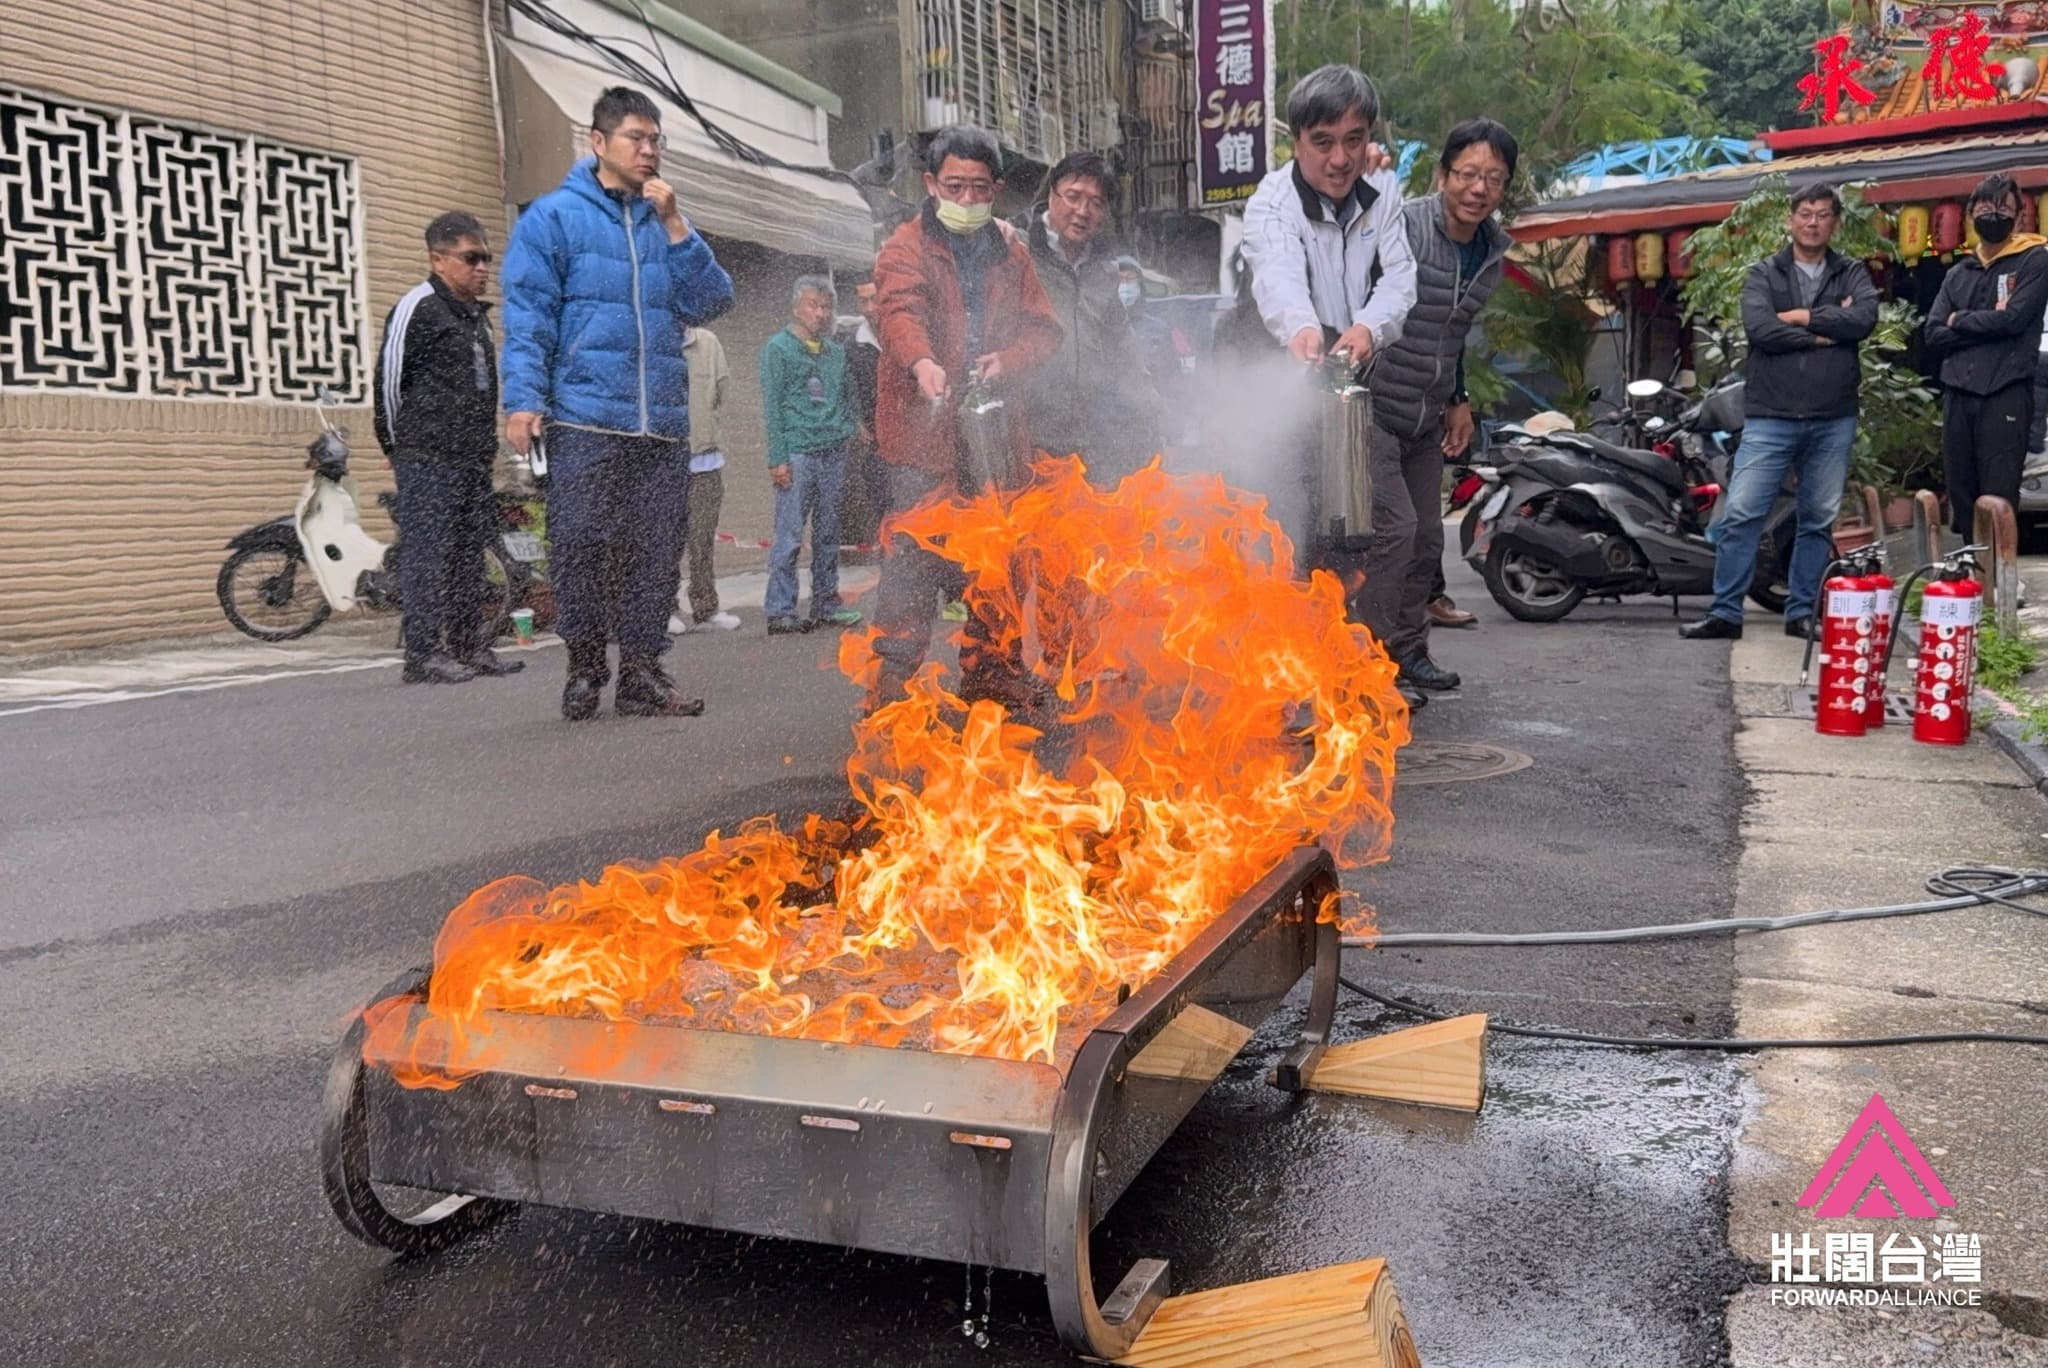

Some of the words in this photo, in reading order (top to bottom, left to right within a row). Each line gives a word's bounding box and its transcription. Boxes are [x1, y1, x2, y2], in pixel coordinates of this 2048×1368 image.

[1217, 4, 1253, 85] 三德
[1201, 89, 1264, 132] Spa
[1215, 132, 1254, 174] 館
